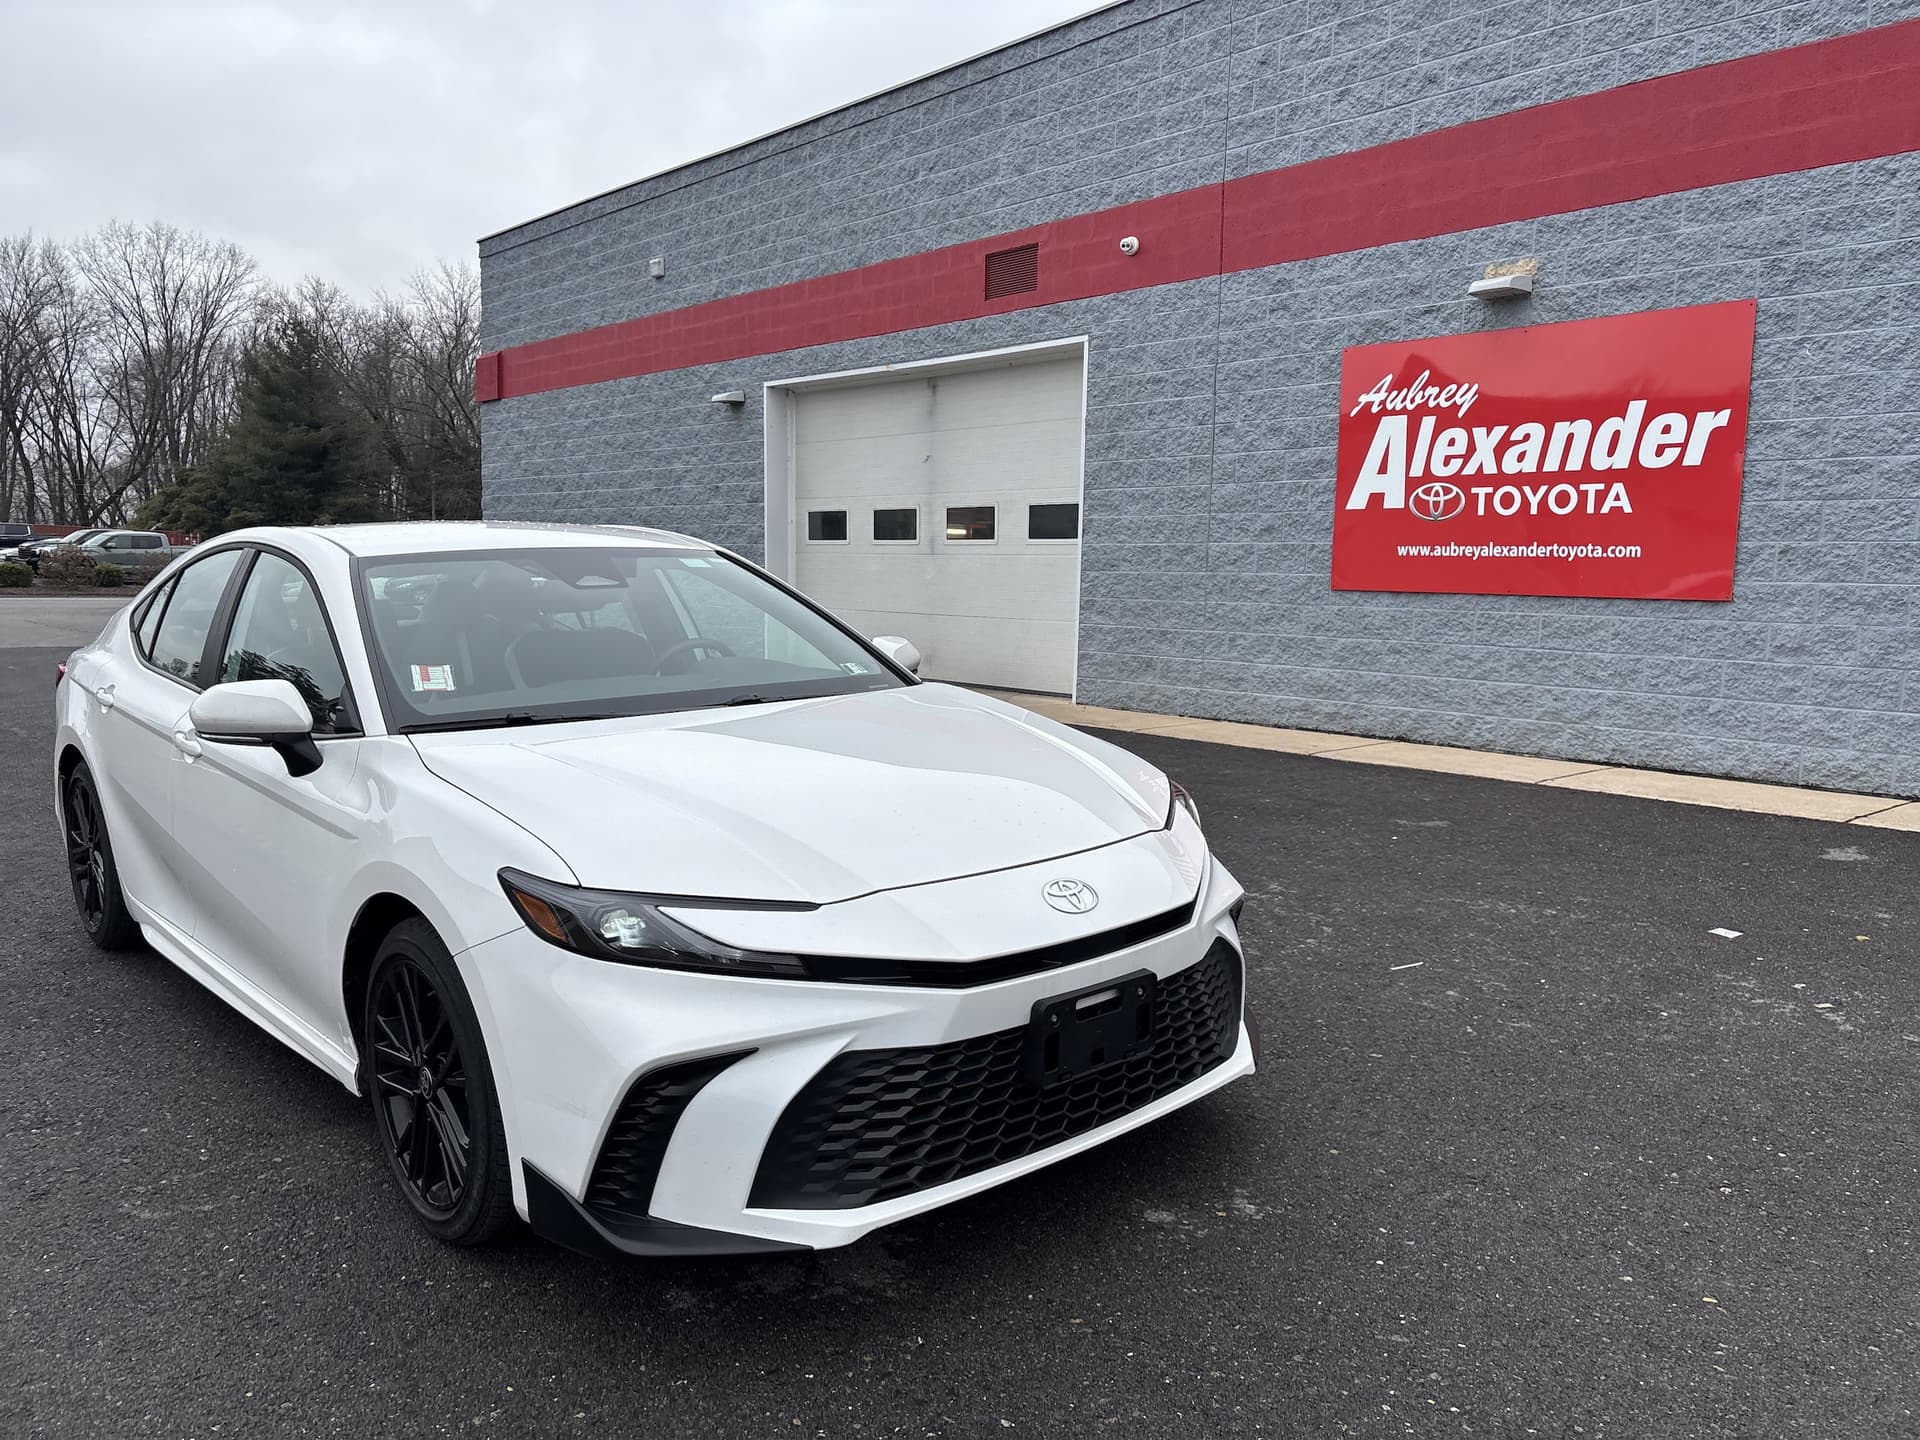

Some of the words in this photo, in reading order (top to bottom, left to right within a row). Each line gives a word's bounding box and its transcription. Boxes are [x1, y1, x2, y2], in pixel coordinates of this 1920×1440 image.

[1350, 369, 1479, 418] Aubrey
[1345, 400, 1732, 510] Alexander
[1471, 482, 1633, 516] TOYOTA
[1397, 541, 1641, 560] www.aubreyalexandertoyota.com
